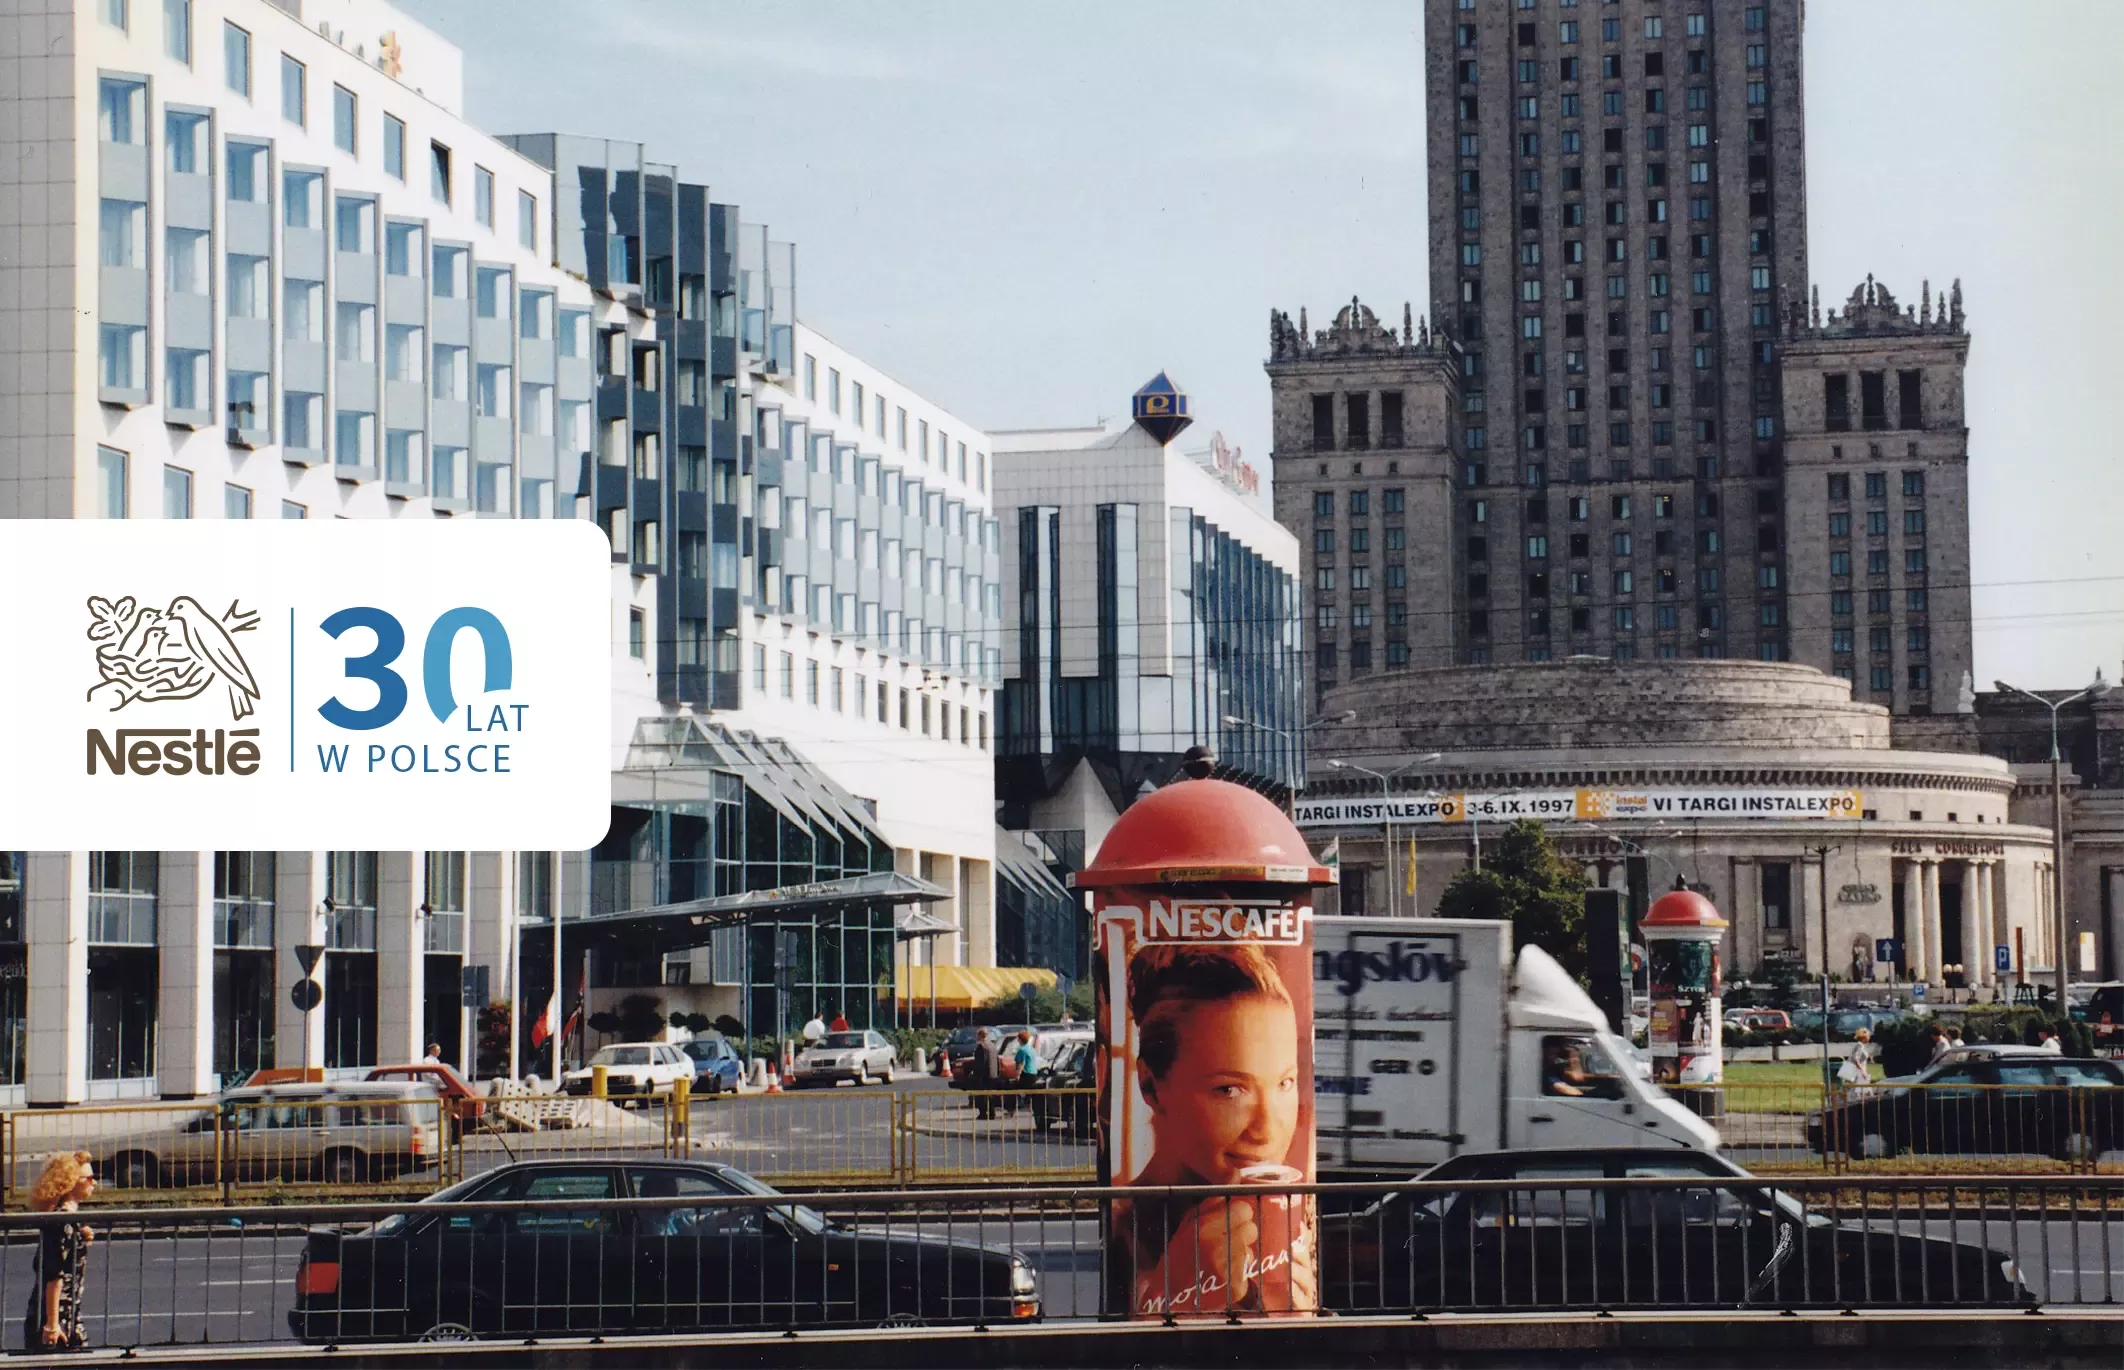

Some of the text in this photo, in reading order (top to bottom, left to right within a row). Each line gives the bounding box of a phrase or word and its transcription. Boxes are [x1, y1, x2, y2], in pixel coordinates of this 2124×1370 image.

[1295, 802, 1455, 821] TARGI INSTALEXPO
[1653, 796, 1854, 811] VI TARGI INSTALEXPO
[1149, 899, 1297, 938] NESCAFÉ
